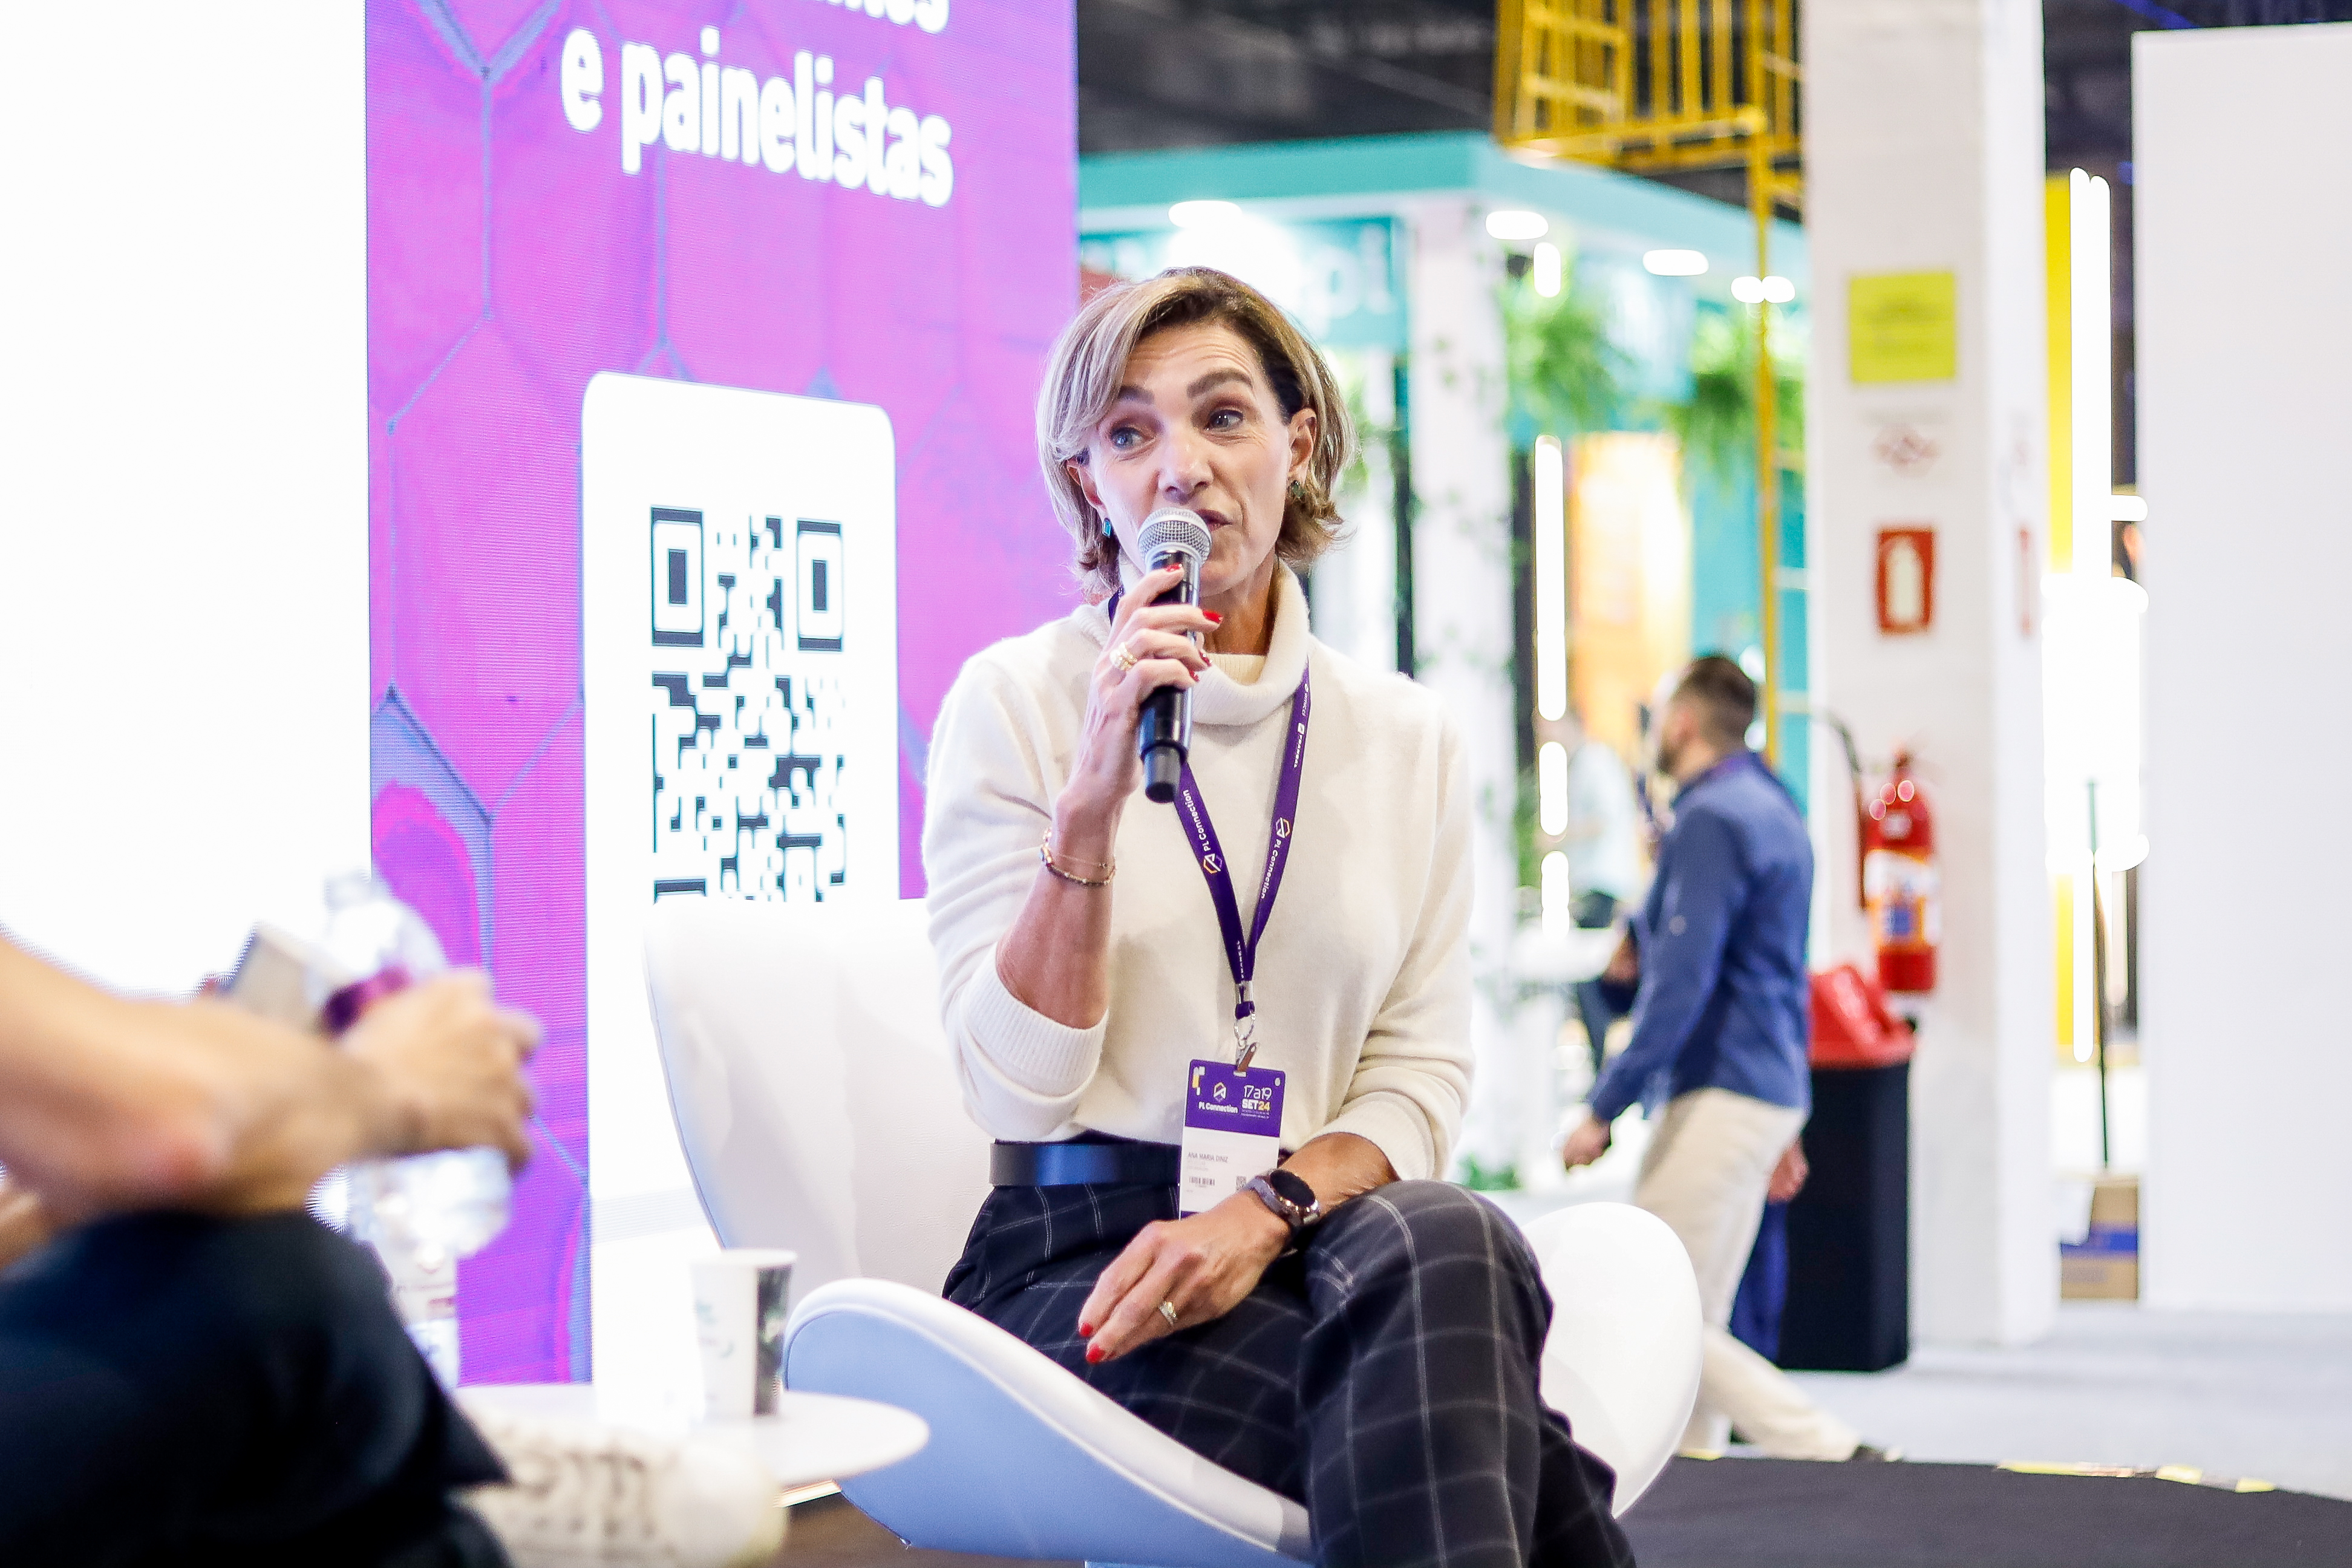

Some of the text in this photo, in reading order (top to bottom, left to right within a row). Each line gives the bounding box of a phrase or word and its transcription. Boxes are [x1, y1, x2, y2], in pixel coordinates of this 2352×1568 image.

[560, 25, 954, 208] e painelistas
[1183, 789, 1207, 840] Connection
[1261, 849, 1278, 899] Connection
[1206, 1102, 1238, 1114] Connection
